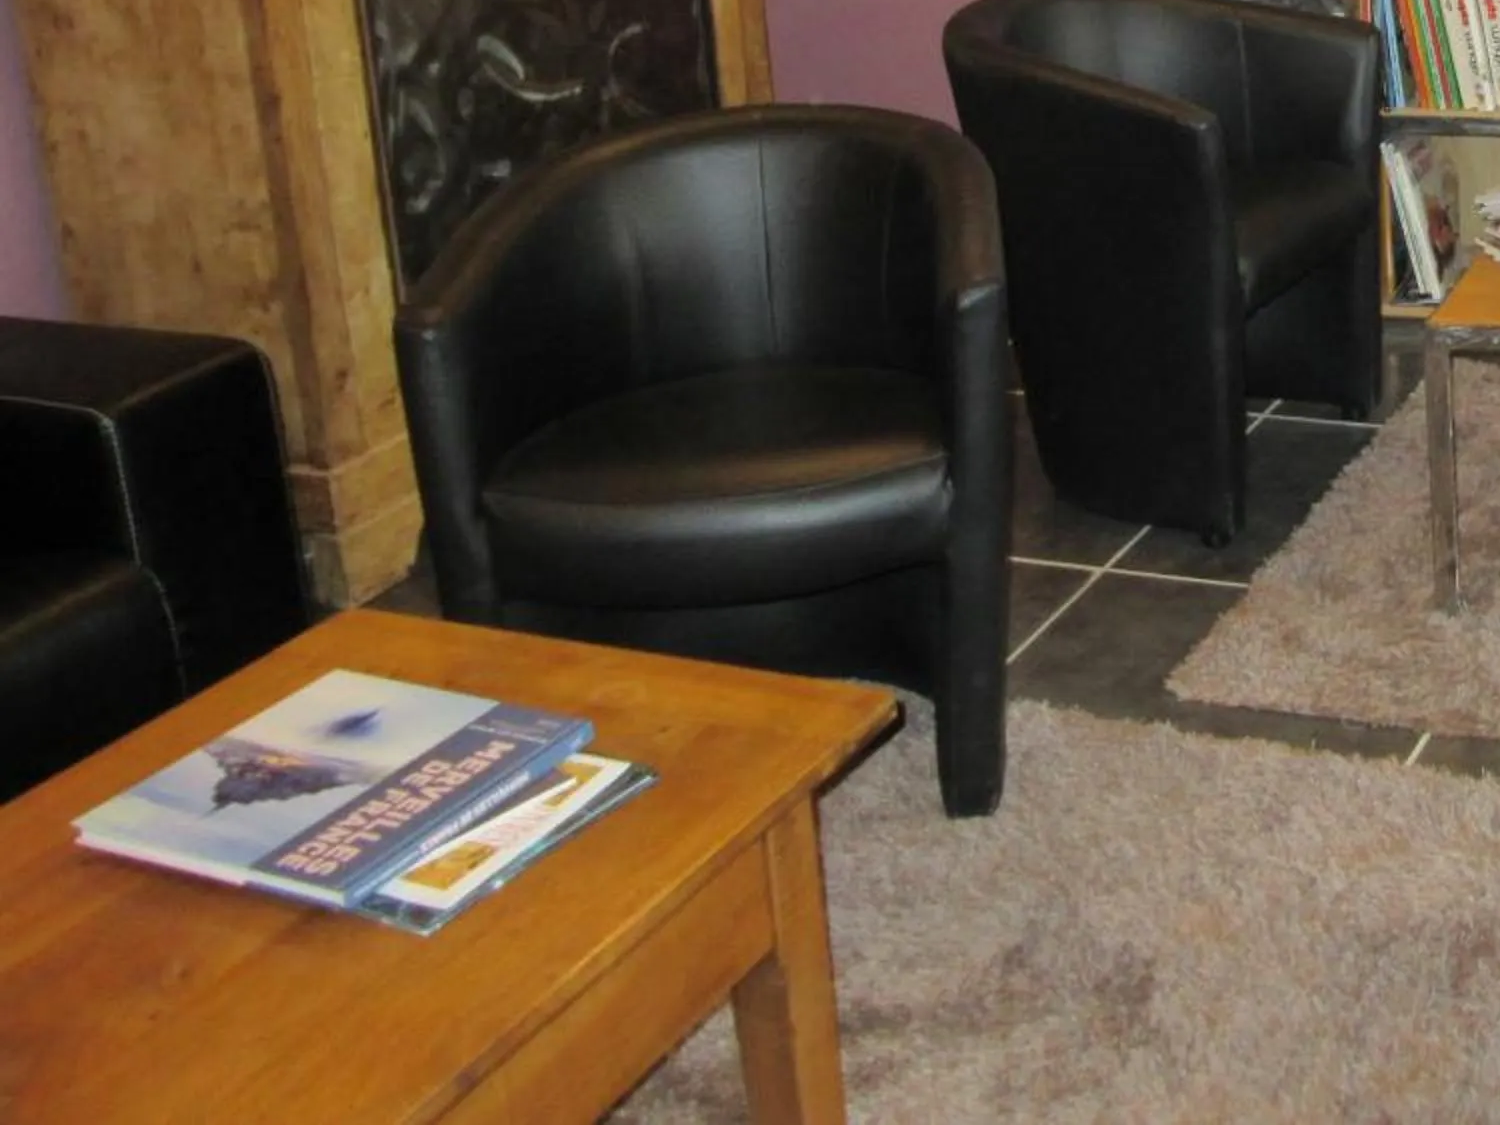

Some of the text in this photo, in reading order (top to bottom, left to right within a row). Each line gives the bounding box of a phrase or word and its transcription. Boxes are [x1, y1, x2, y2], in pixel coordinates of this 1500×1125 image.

[305, 739, 516, 876] MERVEILLES
[400, 759, 452, 787] DE
[275, 787, 409, 870] FRANCE
